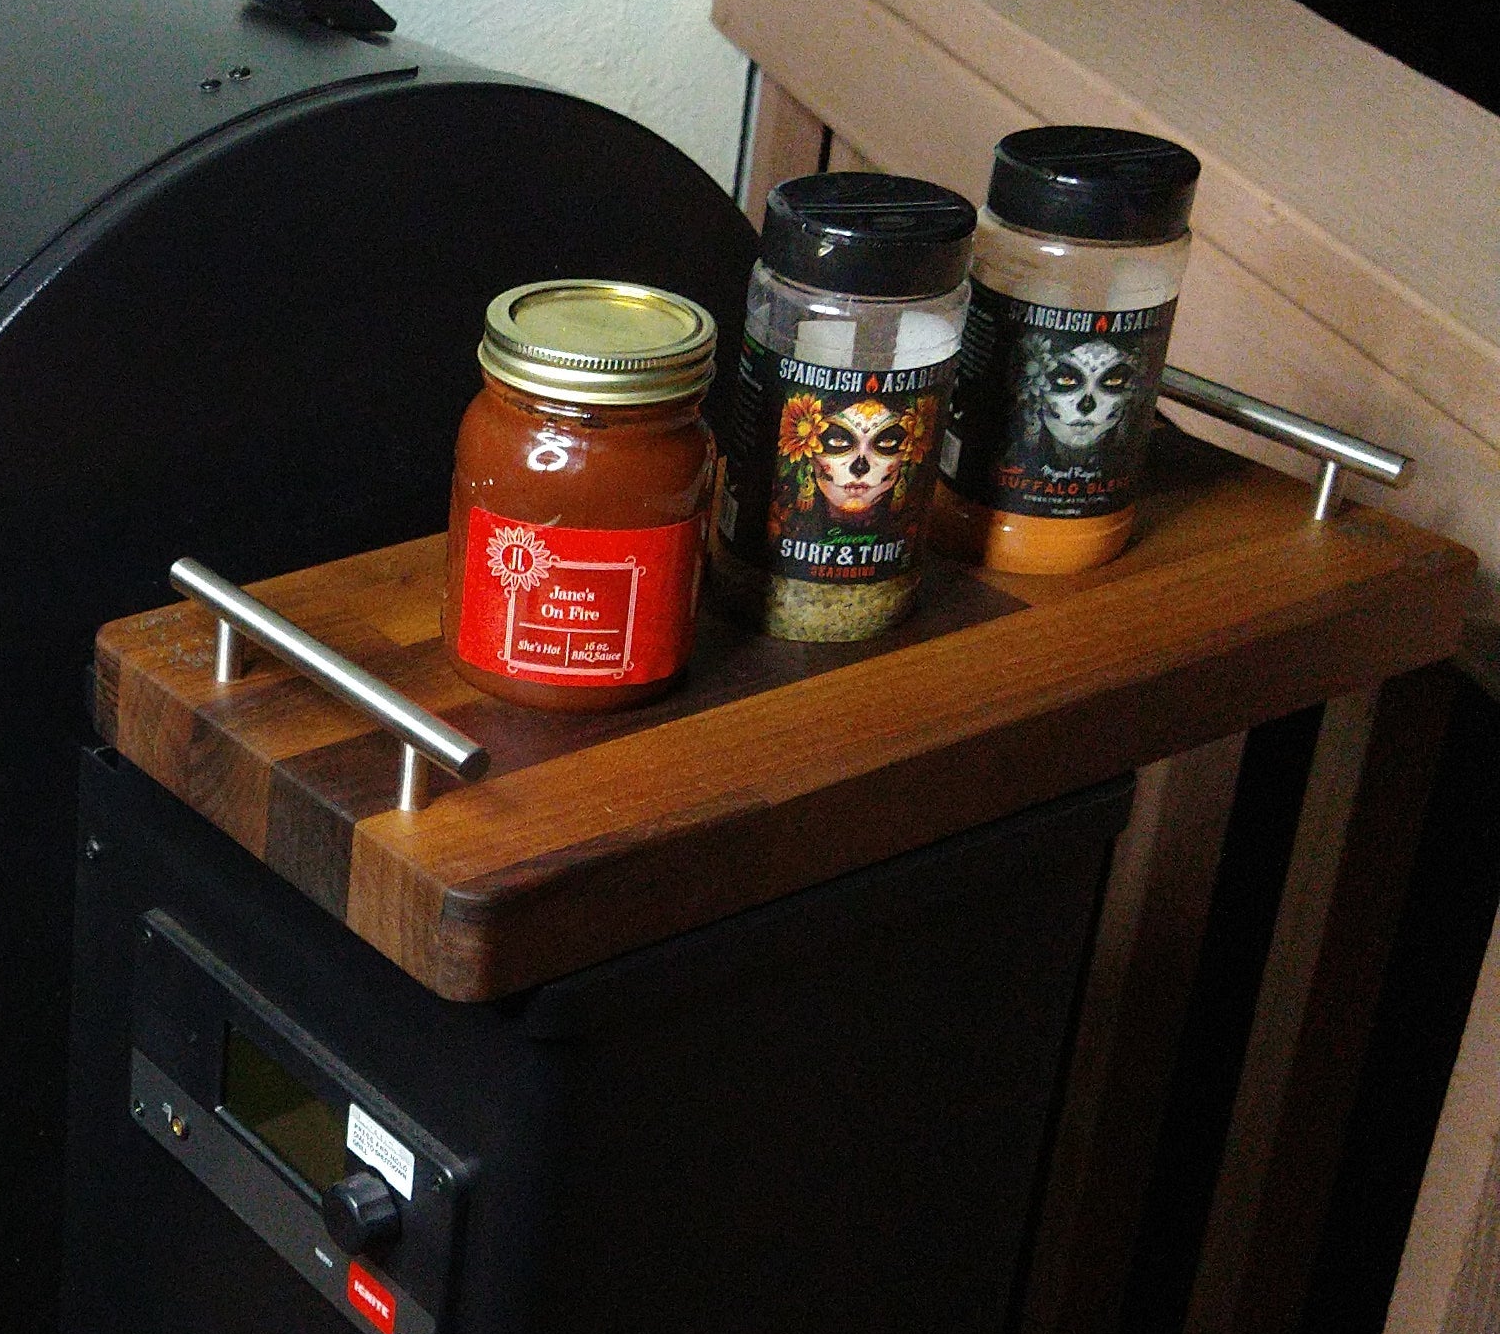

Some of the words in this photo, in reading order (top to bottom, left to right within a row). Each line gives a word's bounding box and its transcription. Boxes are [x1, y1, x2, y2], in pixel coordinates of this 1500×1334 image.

[779, 358, 863, 393] SPANGLISH
[998, 474, 1080, 495] BUFFALO
[780, 538, 835, 565] SURF
[836, 545, 854, 566] &
[859, 539, 905, 565] TURF
[549, 585, 595, 602] Jane's
[540, 604, 564, 620] On
[569, 605, 600, 621] Fire
[517, 639, 542, 653] She's
[542, 643, 562, 655] Hot
[584, 641, 596, 651] 16
[571, 650, 594, 663] BBQ
[594, 650, 622, 661] Sauce
[354, 1279, 390, 1319] IGNITE
